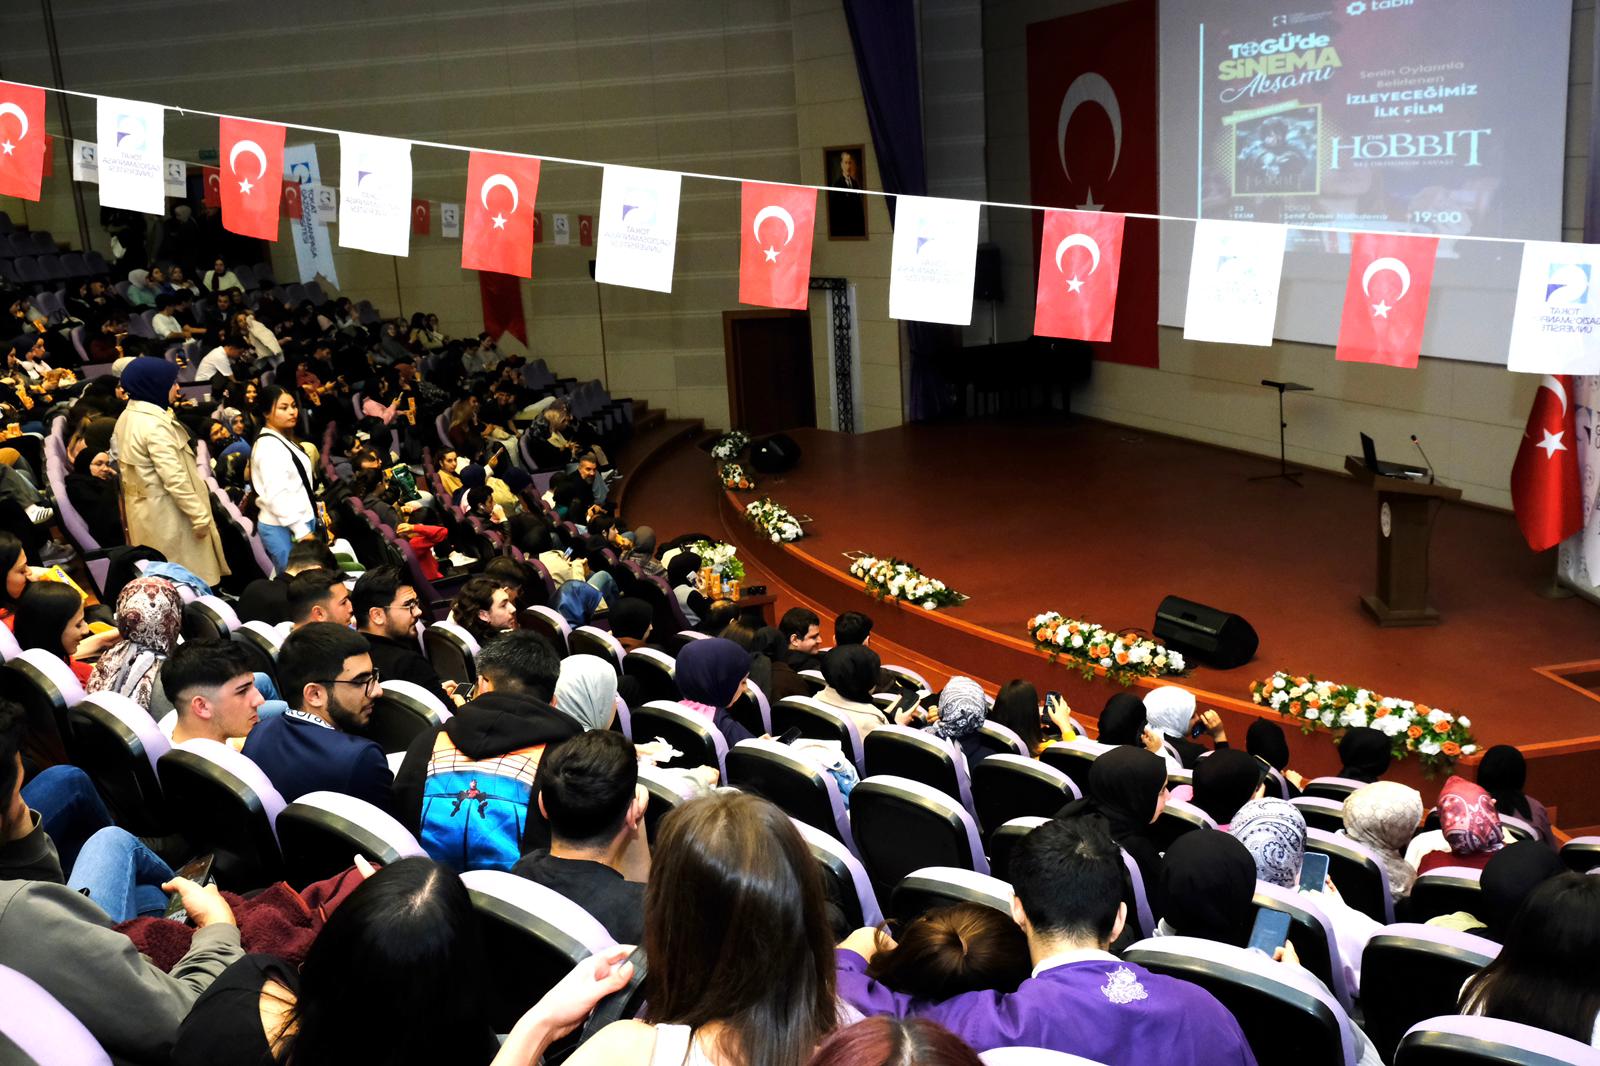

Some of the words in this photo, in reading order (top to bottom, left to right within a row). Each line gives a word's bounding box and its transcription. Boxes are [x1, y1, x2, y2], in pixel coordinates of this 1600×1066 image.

[1346, 82, 1478, 105] İZLEYECEĞİMİZ
[1374, 105, 1399, 118] İLK
[1403, 102, 1444, 116] FİLM
[1329, 128, 1492, 170] HOBBIT
[1413, 211, 1462, 223] 19:00
